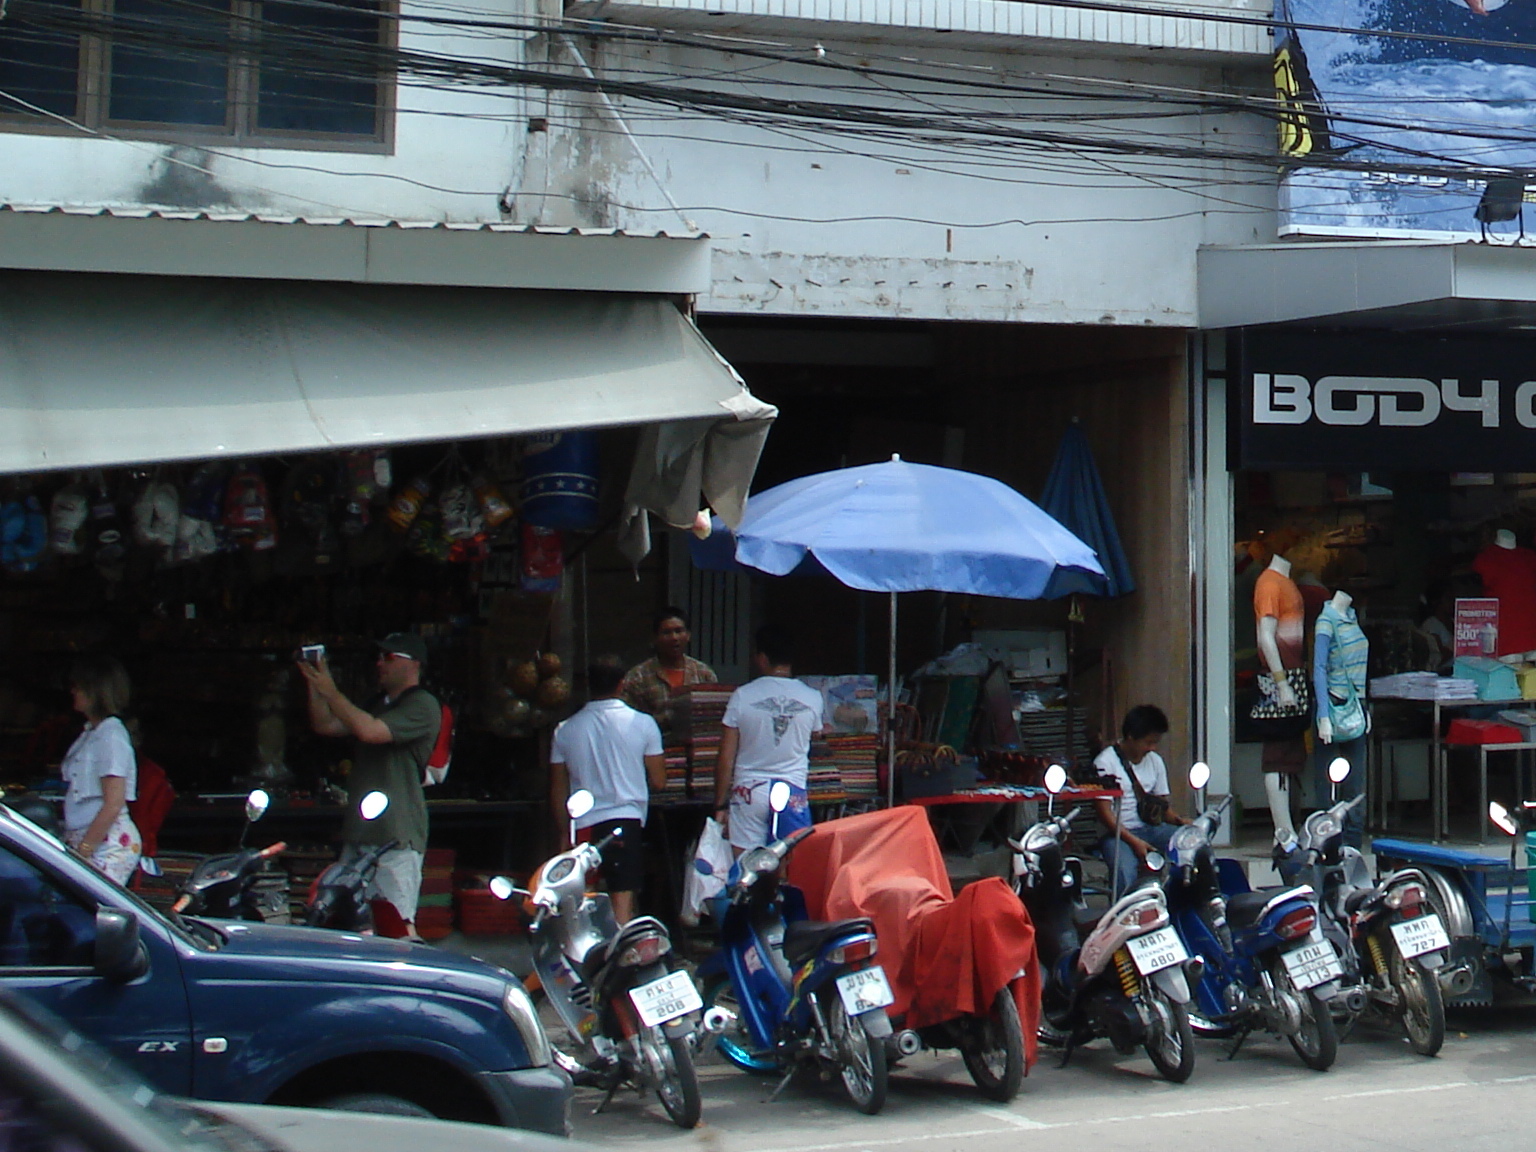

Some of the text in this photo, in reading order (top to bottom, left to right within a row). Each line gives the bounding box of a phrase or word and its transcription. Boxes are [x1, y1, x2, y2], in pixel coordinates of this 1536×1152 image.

[1253, 373, 1500, 428] BODY
[1411, 938, 1436, 953] 727
[1151, 952, 1176, 968] 480
[1307, 966, 1330, 984] 113
[656, 1000, 685, 1017] 208
[138, 1041, 179, 1052] EX
